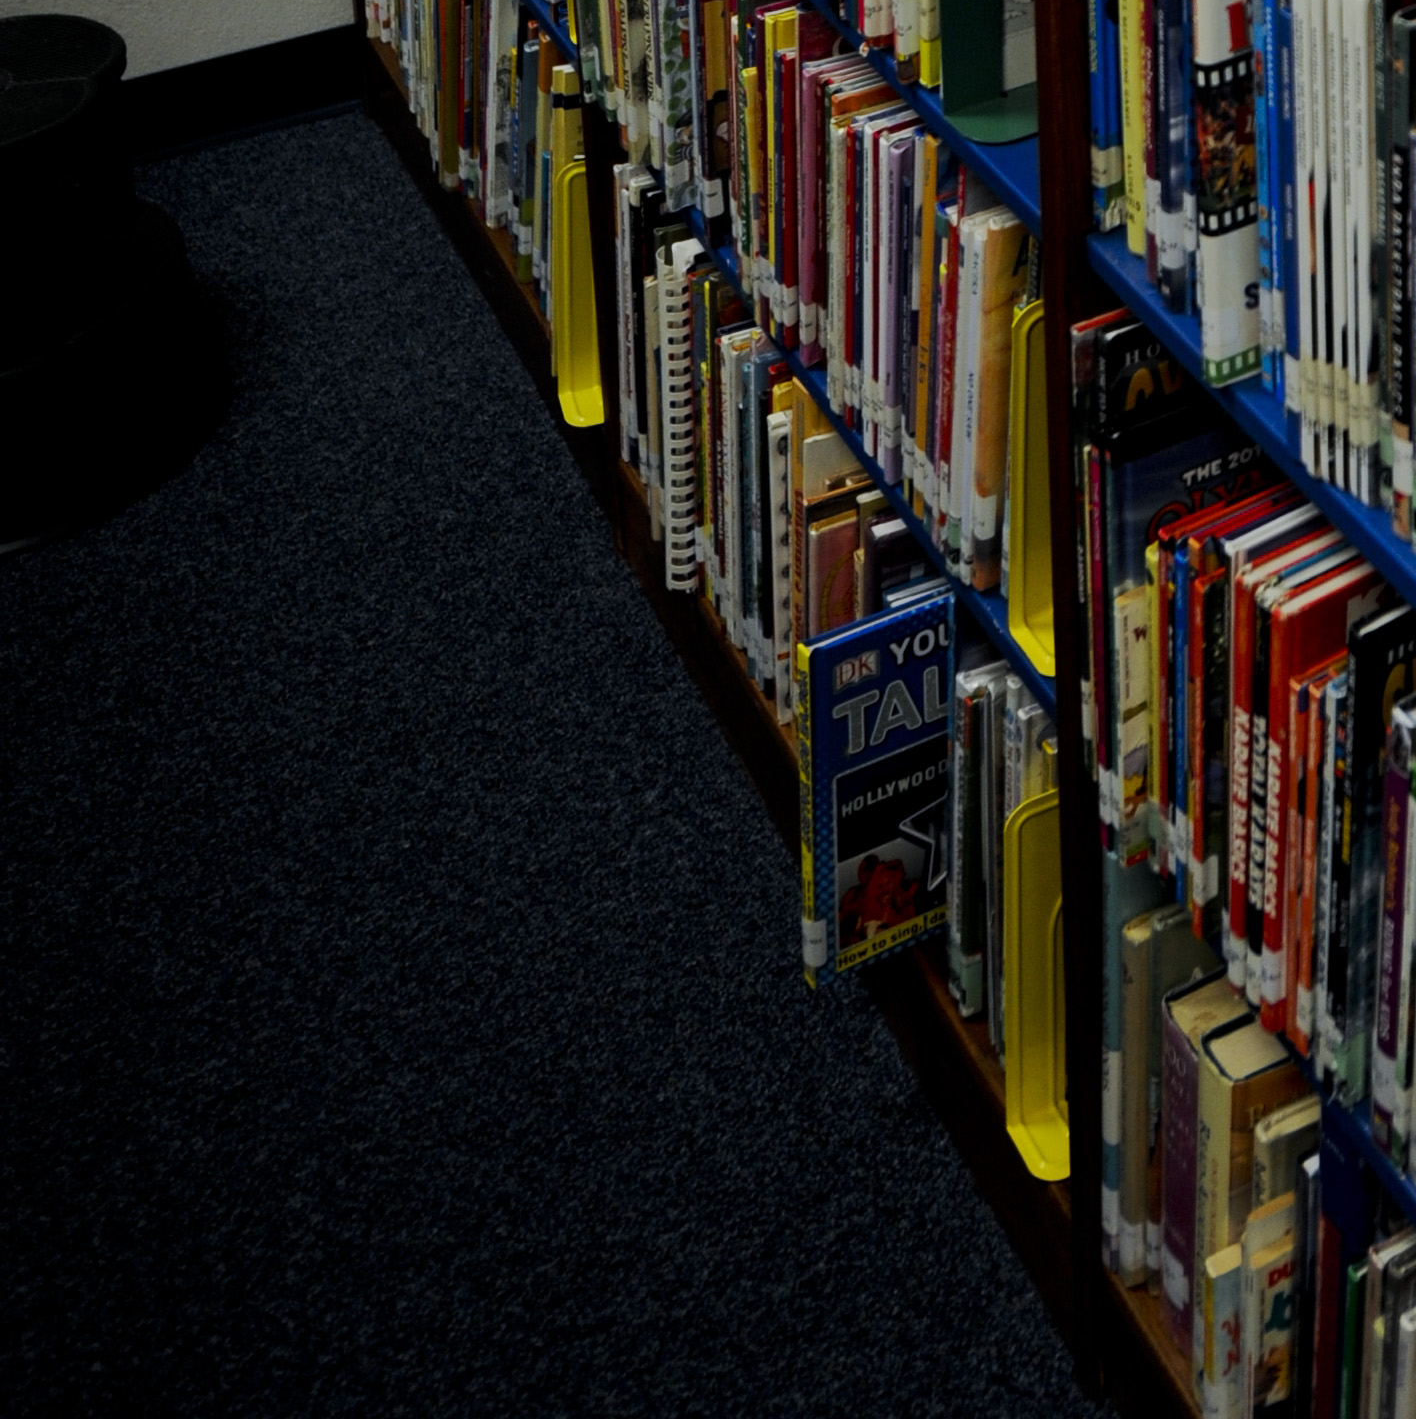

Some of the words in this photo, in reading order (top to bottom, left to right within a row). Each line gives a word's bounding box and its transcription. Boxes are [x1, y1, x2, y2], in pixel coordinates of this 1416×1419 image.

[1375, 70, 1385, 112] BEST
[1375, 158, 1386, 245] BASKETBALL
[1182, 457, 1225, 488] THE
[831, 664, 950, 756] TAL
[834, 651, 879, 690] DK
[840, 762, 948, 820] HOLLYWOOD
[1233, 706, 1250, 796] KARATE
[1250, 714, 1267, 797] TOTAL
[1265, 737, 1282, 832] KARATE
[1231, 801, 1247, 884] BASICS
[1249, 807, 1265, 911] KARATE
[1263, 836, 1279, 919] BASICS
[838, 946, 866, 970] How
[869, 938, 887, 955] to
[890, 920, 924, 949] sing,
